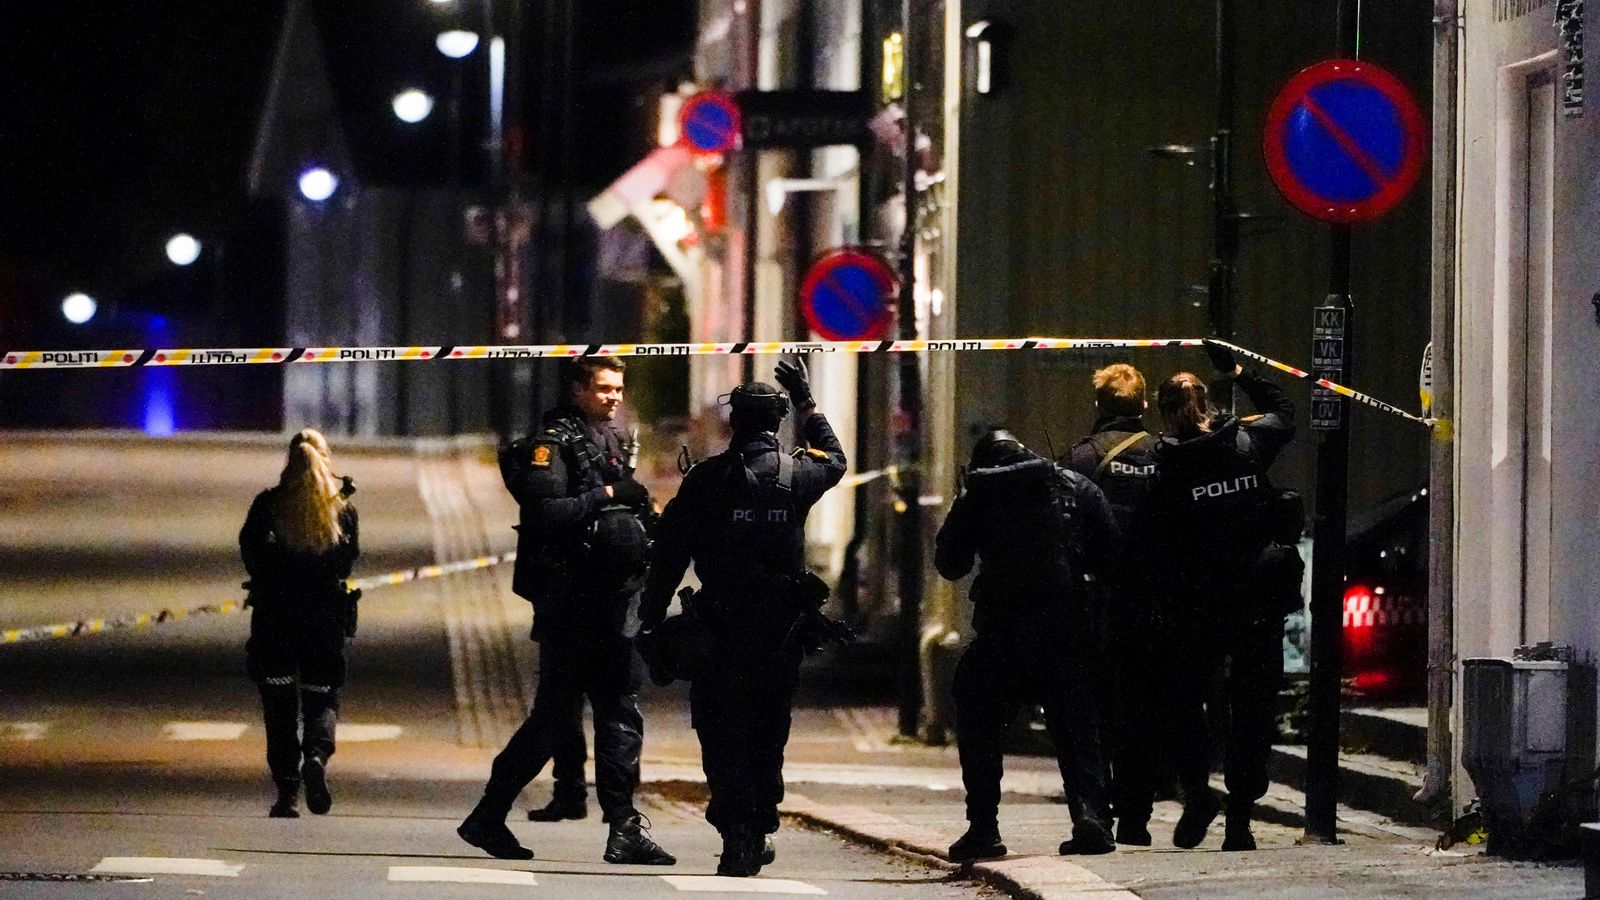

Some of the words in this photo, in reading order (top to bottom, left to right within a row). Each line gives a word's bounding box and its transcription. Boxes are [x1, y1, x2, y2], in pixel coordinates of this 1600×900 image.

[340, 350, 395, 359] POLITI
[1320, 342, 1338, 357] VK
[42, 352, 99, 363] POLITI
[192, 353, 247, 363] POLITI
[1110, 461, 1156, 476] POLIT
[1191, 474, 1259, 500] POLITI
[733, 510, 788, 521] POITI
